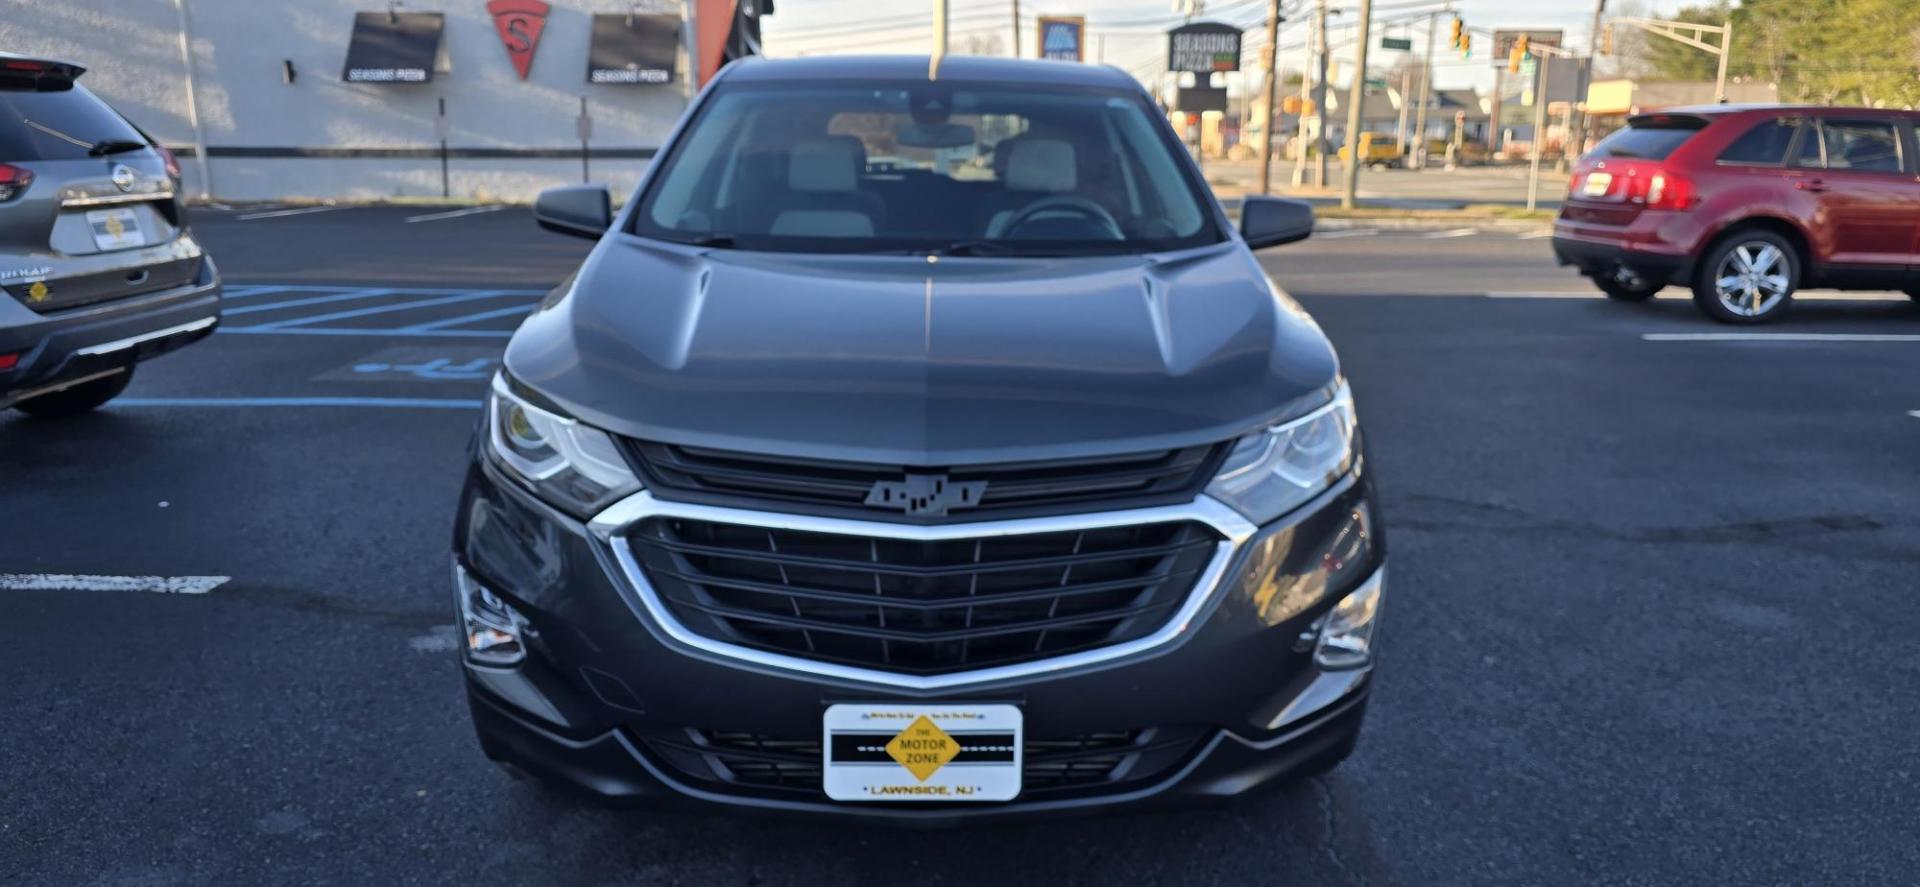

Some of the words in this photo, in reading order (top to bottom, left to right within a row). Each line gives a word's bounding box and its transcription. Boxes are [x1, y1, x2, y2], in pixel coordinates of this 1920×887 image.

[506, 18, 531, 53] S
[1174, 33, 1238, 52] SEASONS
[1173, 53, 1212, 71] PIZZA
[349, 68, 394, 81] SEASONS
[592, 69, 639, 82] SEASONS
[900, 739, 946, 750] MOTOR
[906, 753, 940, 763] ZONE
[871, 785, 951, 795] LAWNSIDE,
[956, 785, 973, 794] NJ
